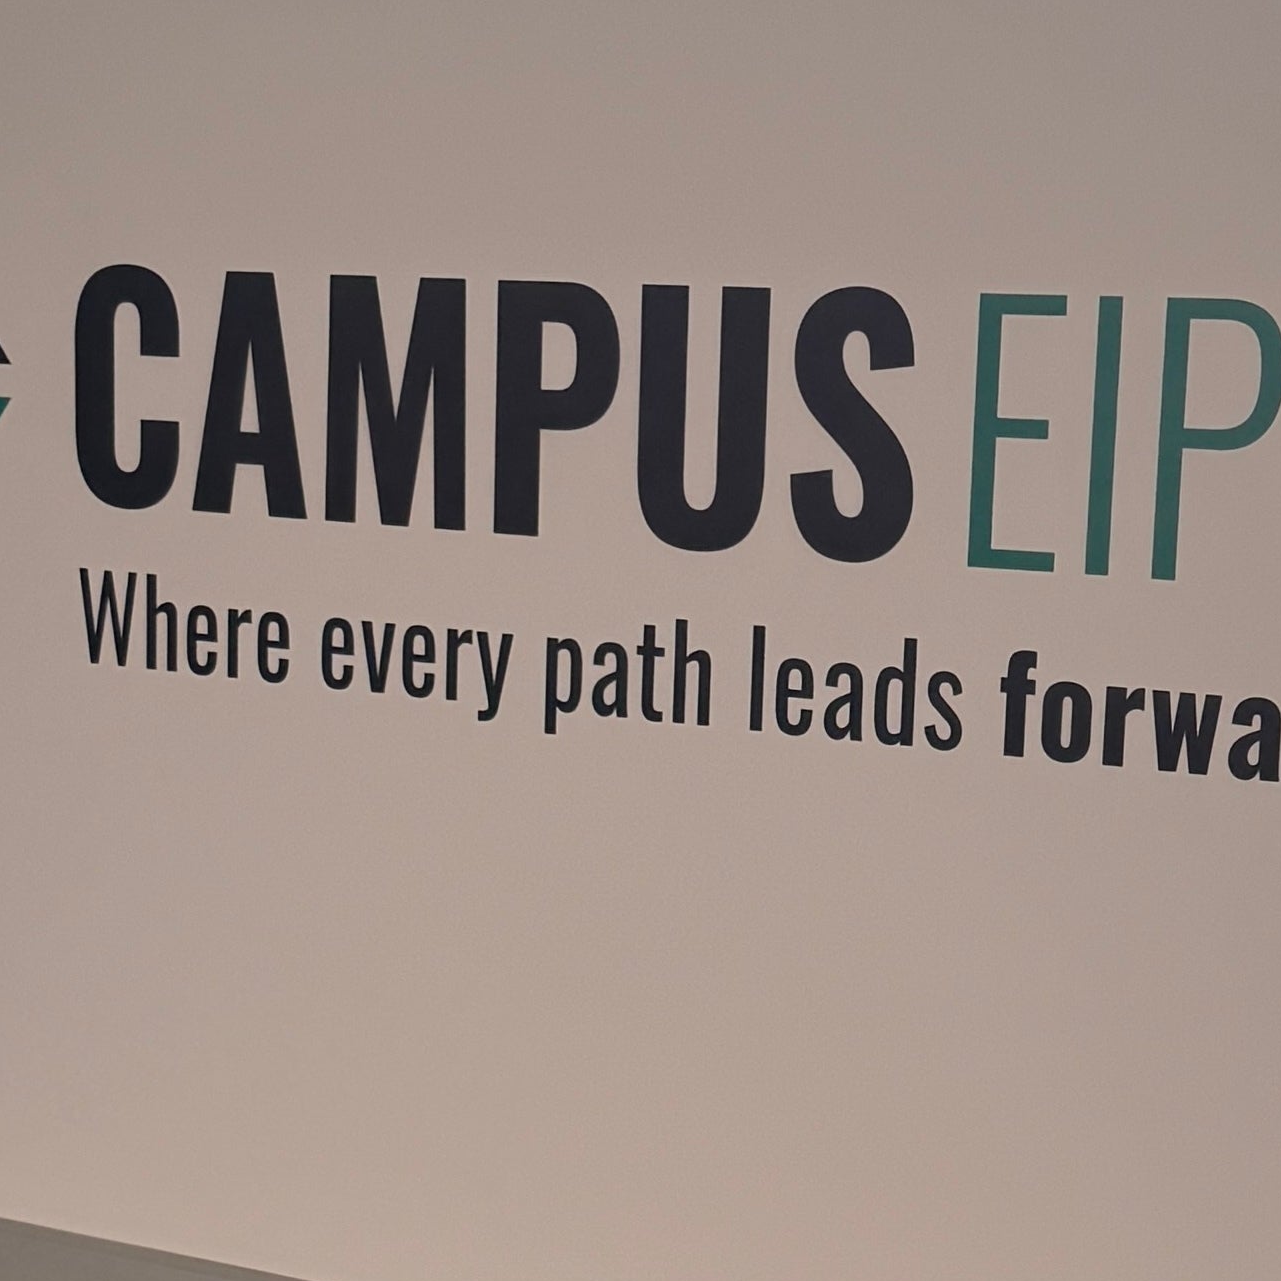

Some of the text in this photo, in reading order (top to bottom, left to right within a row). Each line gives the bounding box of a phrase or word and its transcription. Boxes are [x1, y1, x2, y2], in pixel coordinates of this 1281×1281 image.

[73, 263, 916, 564] CAMPUS
[78, 567, 291, 684] Where
[321, 617, 515, 722] every
[543, 618, 712, 735] path
[749, 624, 963, 752] leads
